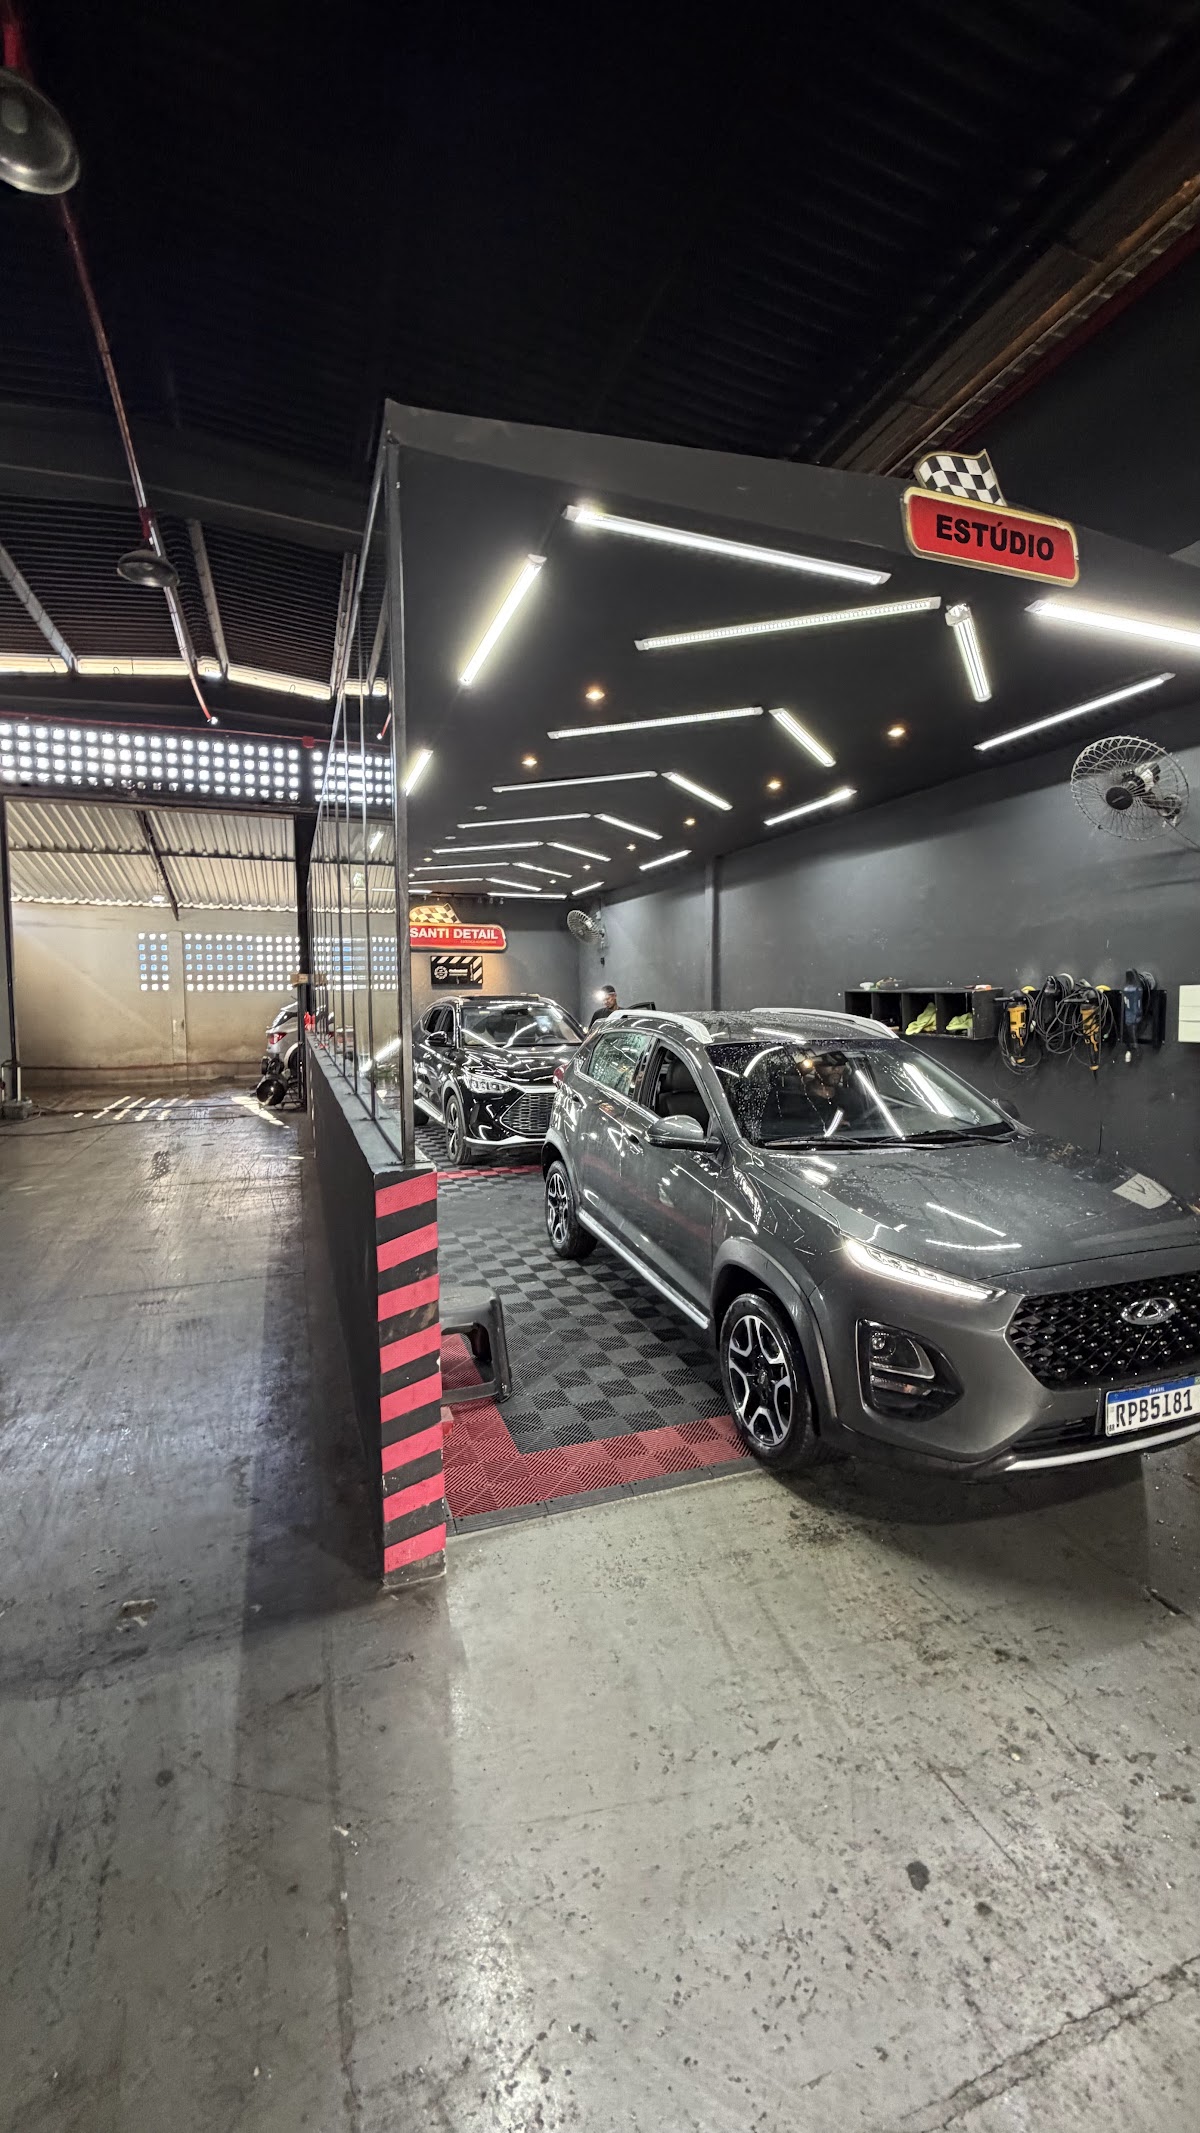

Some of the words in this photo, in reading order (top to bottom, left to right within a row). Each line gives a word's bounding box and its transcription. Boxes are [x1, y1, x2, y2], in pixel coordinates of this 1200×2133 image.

[936, 514, 1054, 561] ESTÚDIO
[410, 927, 449, 938] SANTI
[453, 928, 498, 939] DETAIL
